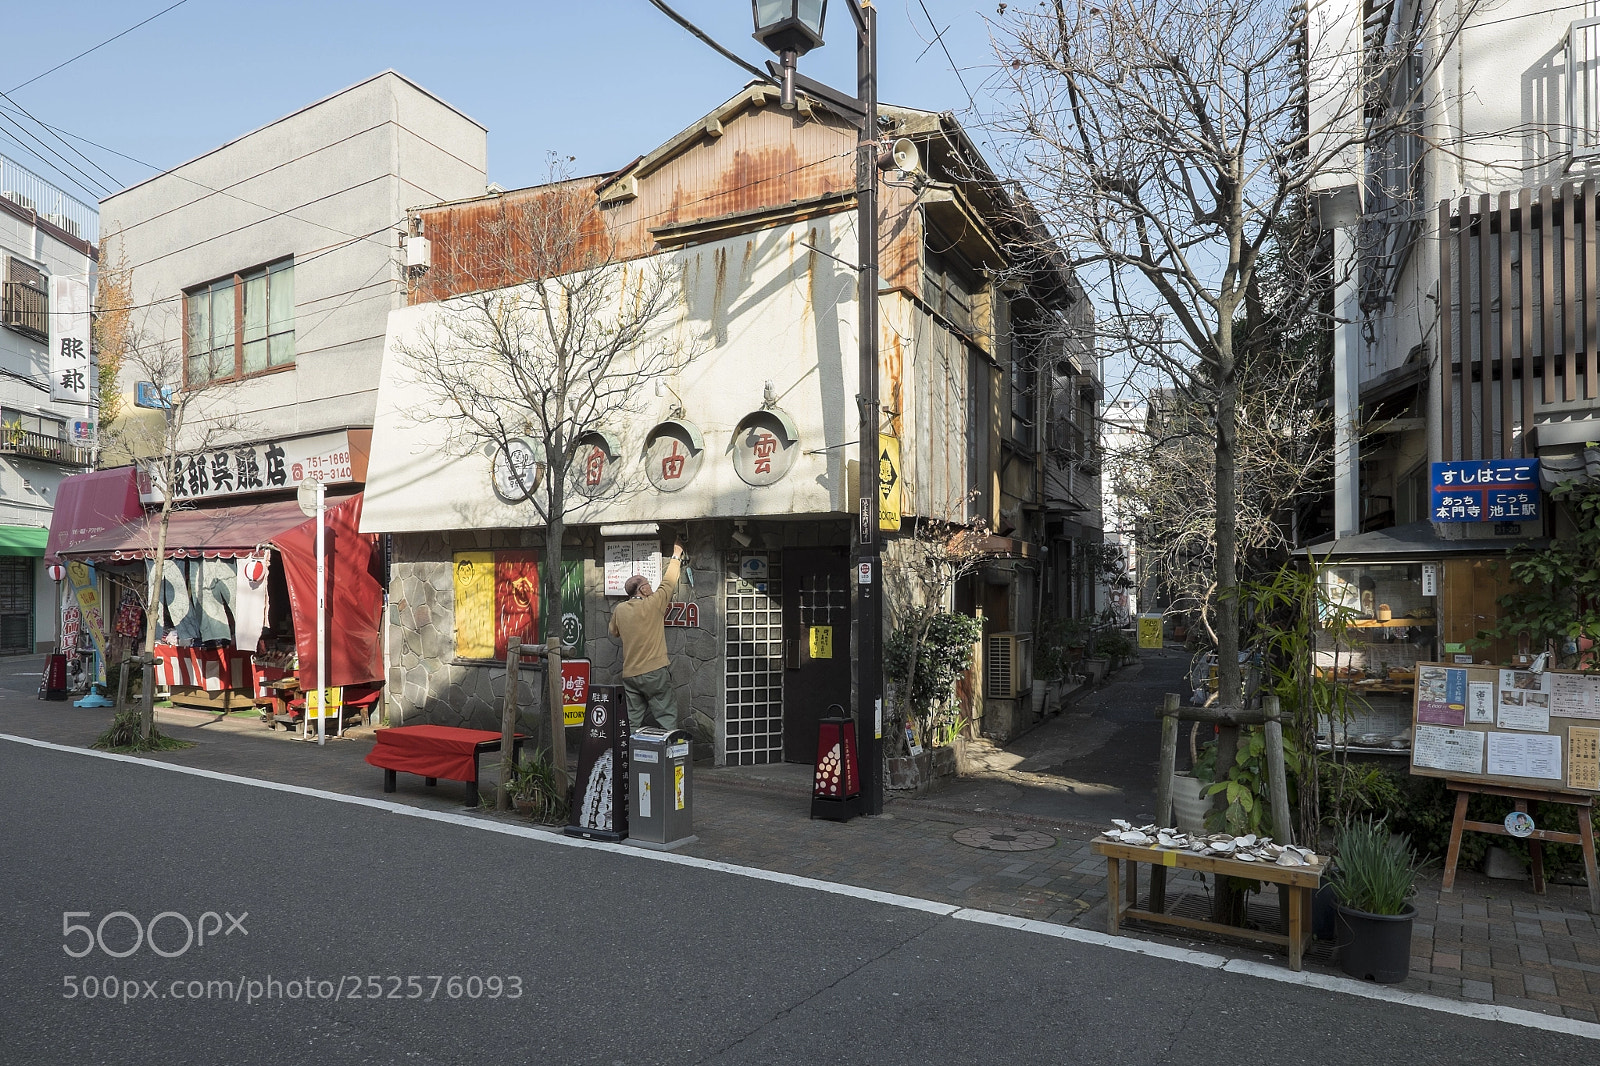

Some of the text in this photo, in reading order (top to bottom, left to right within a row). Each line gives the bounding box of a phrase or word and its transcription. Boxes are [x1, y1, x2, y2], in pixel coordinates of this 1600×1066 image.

[1441, 466, 1531, 485] すしはここ
[1442, 495, 1474, 506] あっち
[1496, 493, 1528, 504] こっち
[1436, 505, 1481, 519] 本門寺
[1488, 503, 1536, 519] 池上駅
[563, 711, 585, 719] NTORY
